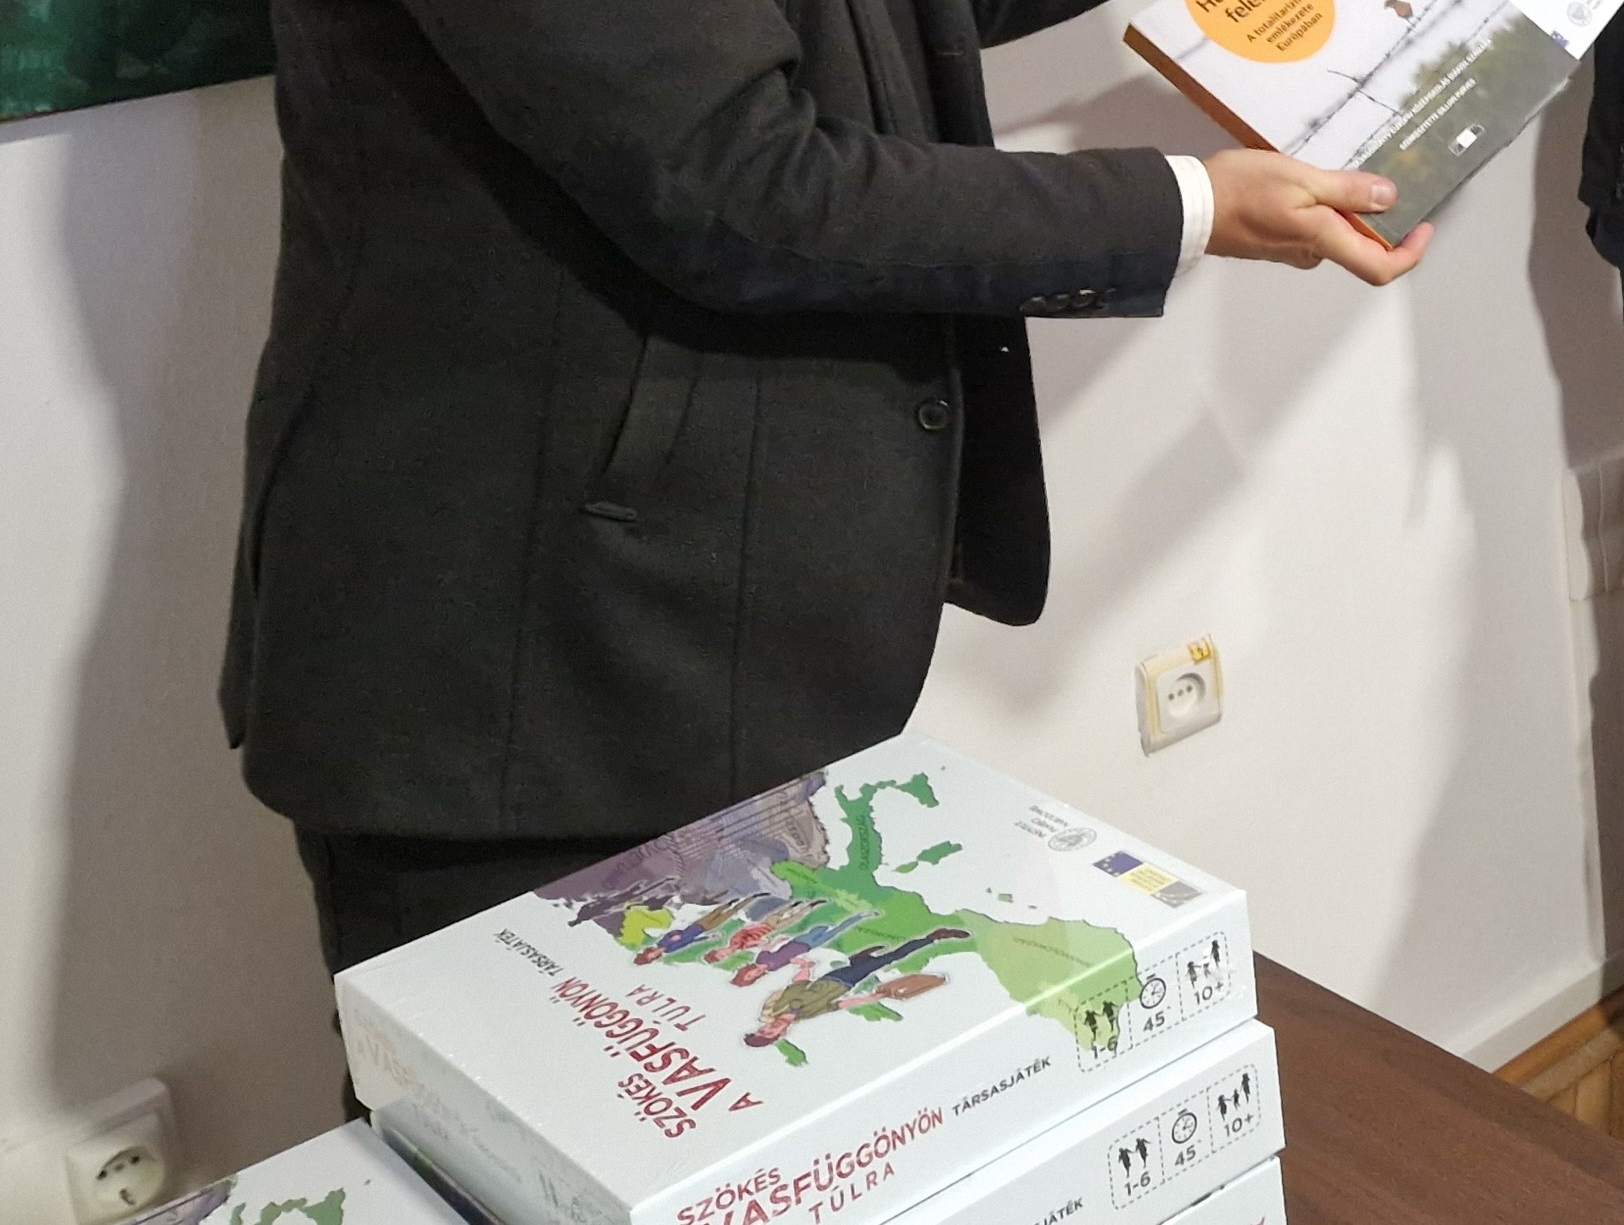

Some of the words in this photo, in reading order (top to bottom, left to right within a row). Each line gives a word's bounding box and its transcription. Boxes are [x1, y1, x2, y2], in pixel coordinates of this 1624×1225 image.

[1246, 33, 1256, 43] A
[493, 928, 563, 977] TÁRSASJÁTÉK
[625, 984, 707, 1032] TÚLRA
[1194, 981, 1226, 1006] 10+
[549, 977, 731, 1112] VASFÜGGÖNYÖN
[1092, 1035, 1119, 1059] 1-6
[617, 1073, 697, 1139] SZÖKÉS
[728, 1092, 764, 1112] A
[951, 1056, 1051, 1118] TÁRSASJÁTÉK
[1224, 1113, 1254, 1137] 10+
[677, 1167, 782, 1225] SZÖKÉS
[808, 1162, 896, 1225] TÚLRA
[1123, 1171, 1152, 1196] 1-6
[1034, 1197, 1083, 1225] JÁTÉK
